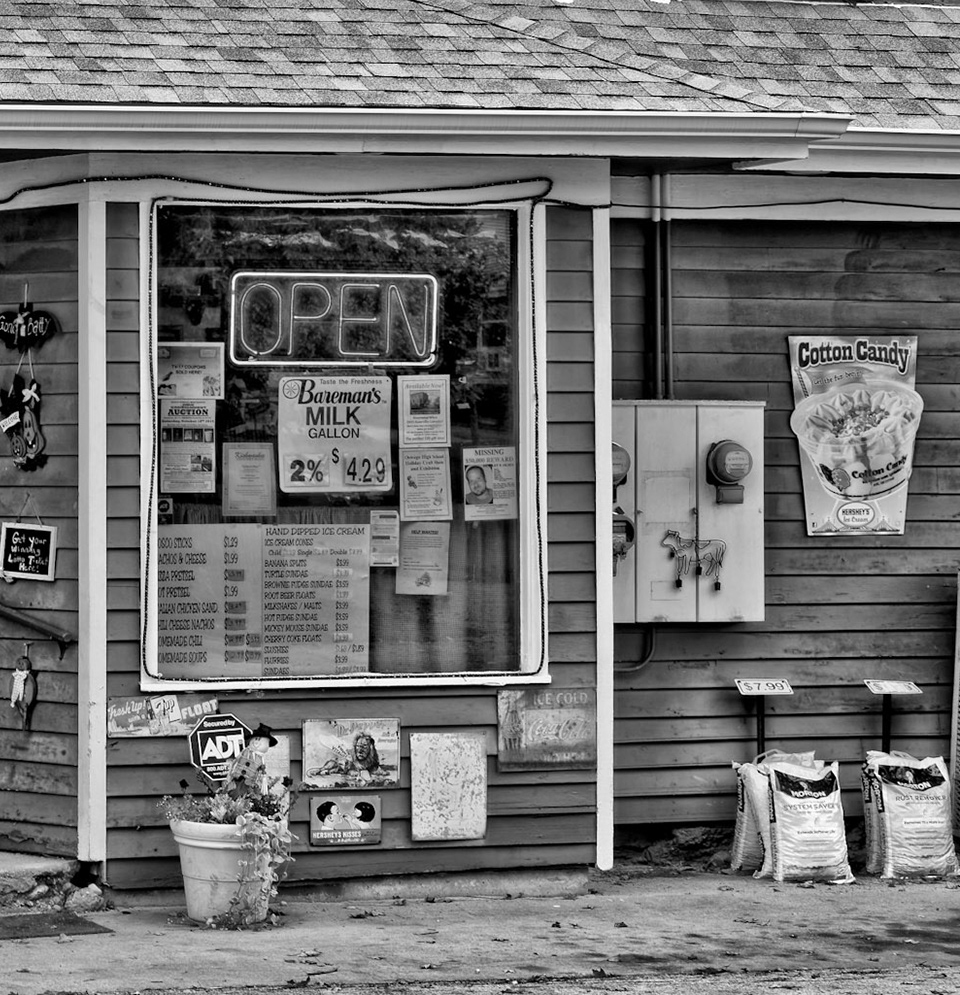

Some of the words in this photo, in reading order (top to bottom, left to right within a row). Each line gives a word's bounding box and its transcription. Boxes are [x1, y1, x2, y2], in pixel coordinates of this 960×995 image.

[240, 282, 429, 356] OPEN
[798, 342, 853, 367] Cotton
[856, 340, 909, 373] Candy
[295, 379, 382, 404] Bareman's
[306, 406, 361, 425] MILK
[308, 428, 360, 439] GALLON
[290, 459, 324, 482] 2%
[331, 447, 340, 464] $
[347, 457, 386, 483] 4.29
[266, 528, 289, 536] HAND
[291, 528, 320, 536] DIPPED
[322, 527, 335, 535] ICE
[336, 527, 365, 536] CREAM
[158, 553, 177, 565] ACHOS
[264, 559, 288, 567] BANANA
[744, 682, 785, 691] $7.99
[533, 693, 553, 705] ICE
[556, 692, 588, 704] COLD
[181, 699, 218, 719] FLOAT
[202, 735, 243, 760] ADT
[791, 790, 826, 798] MORTON
